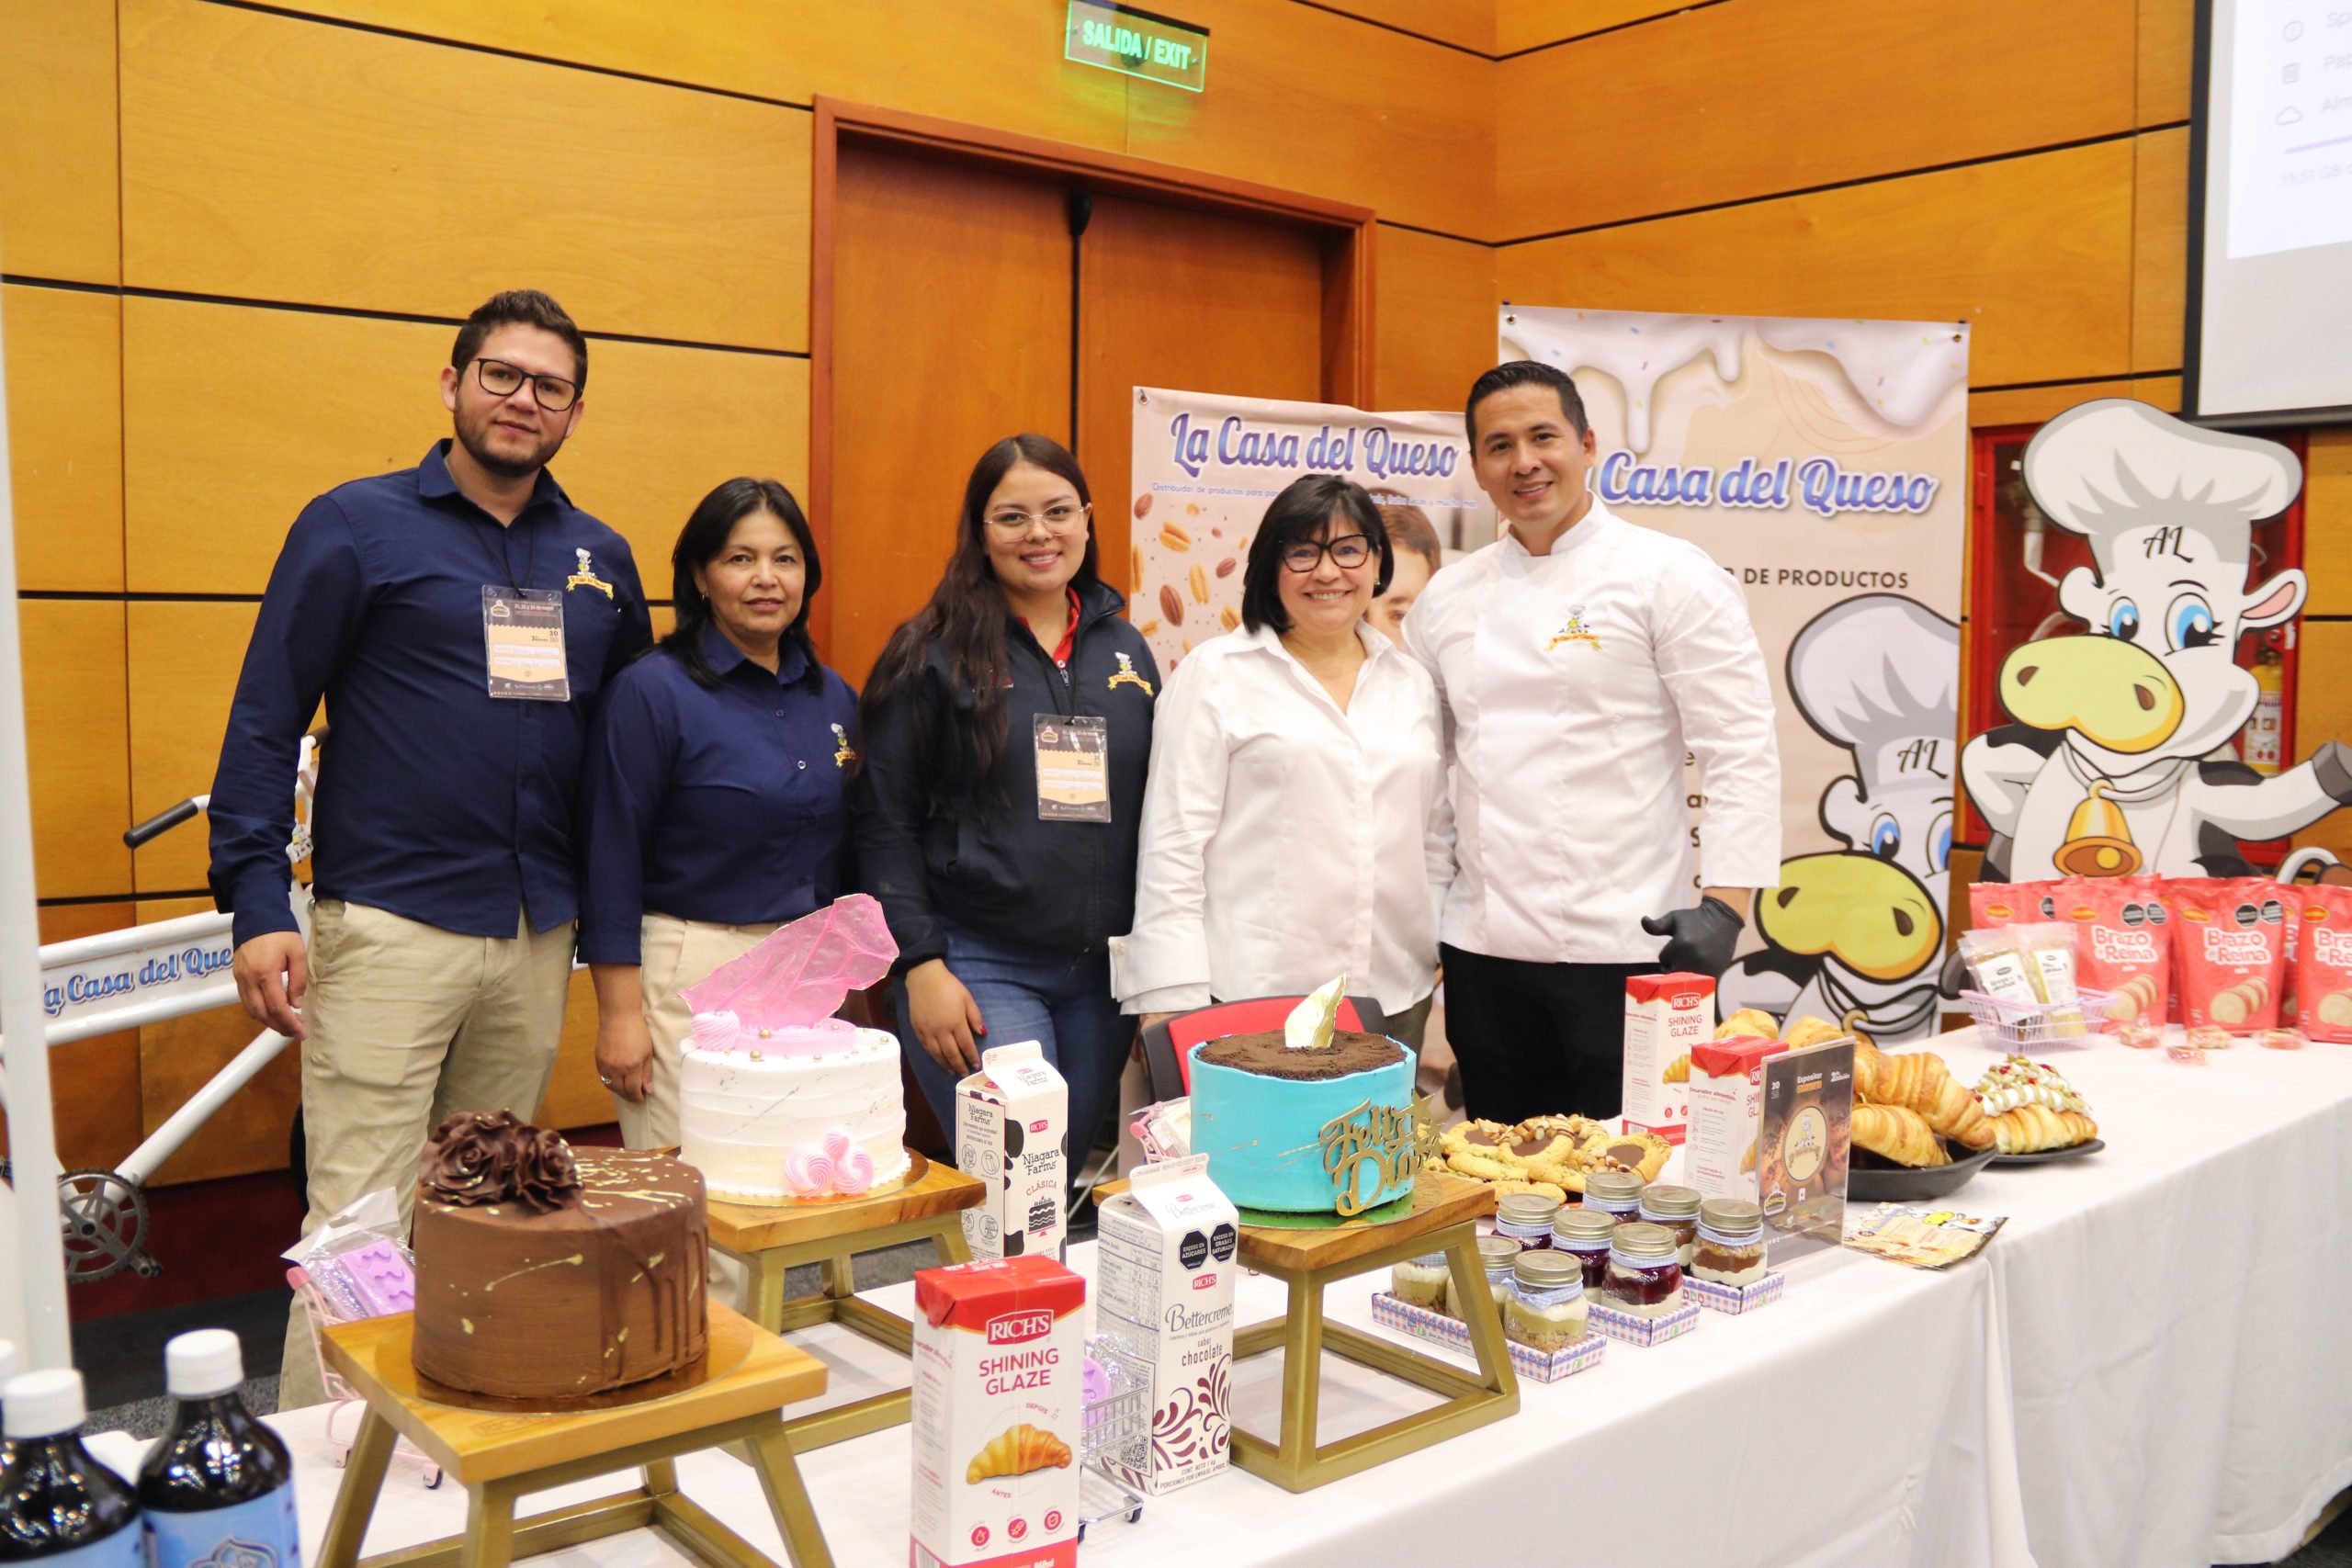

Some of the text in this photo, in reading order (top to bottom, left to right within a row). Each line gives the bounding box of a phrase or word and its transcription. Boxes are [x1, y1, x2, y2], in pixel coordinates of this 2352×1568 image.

[1082, 20, 1192, 70] SALIDA / EXIT
[1170, 412, 1459, 479] La Casa del Queso
[1152, 482, 1193, 492] Distribuidor
[1208, 487, 1243, 496] productos
[1600, 451, 1710, 502] Casa
[1720, 458, 1789, 505] del
[1798, 458, 1933, 513] Queso
[2143, 525, 2195, 562] AL
[1745, 568, 1770, 584] DE
[1778, 569, 1909, 589] PRODUCTOS
[1897, 739, 1949, 779] AL
[2094, 928, 2149, 946] Brazo
[2207, 931, 2264, 947] Brazo
[2318, 930, 2352, 948] Bra
[2105, 945, 2155, 961] Reina
[2218, 947, 2268, 963] Reina
[67, 971, 132, 1003] Casa
[139, 954, 178, 986] del
[182, 947, 233, 977] Que
[1668, 1015, 1702, 1027] SHINING
[1671, 1026, 1699, 1037] GLAZE
[1771, 1081, 1781, 1090] 20
[1797, 1073, 1822, 1084] Expositor
[968, 1102, 993, 1117] Niagara
[970, 1112, 991, 1125] Farms
[1319, 1098, 1415, 1188] Feliz
[1022, 1149, 1059, 1165] Niagara
[1025, 1161, 1057, 1176] Farms
[1025, 1179, 1057, 1196] CLÁSICA
[1214, 1233, 1228, 1241] EXCESO
[1216, 1238, 1232, 1247] GRASAS
[1182, 1247, 1206, 1258] AZÚCARES
[1183, 1244, 1198, 1252] EXCESO
[1165, 1303, 1232, 1332] Bettercreme
[989, 1314, 1050, 1343] RICH'S
[1197, 1337, 1212, 1348] sabor
[1182, 1342, 1223, 1366] chocolate
[979, 1348, 1058, 1377] SHINING
[986, 1370, 1051, 1395] GLAZE
[1025, 1402, 1048, 1415] DEPOIS
[1160, 1477, 1185, 1489] PORCIONES
[991, 1487, 1012, 1499] ANTES
